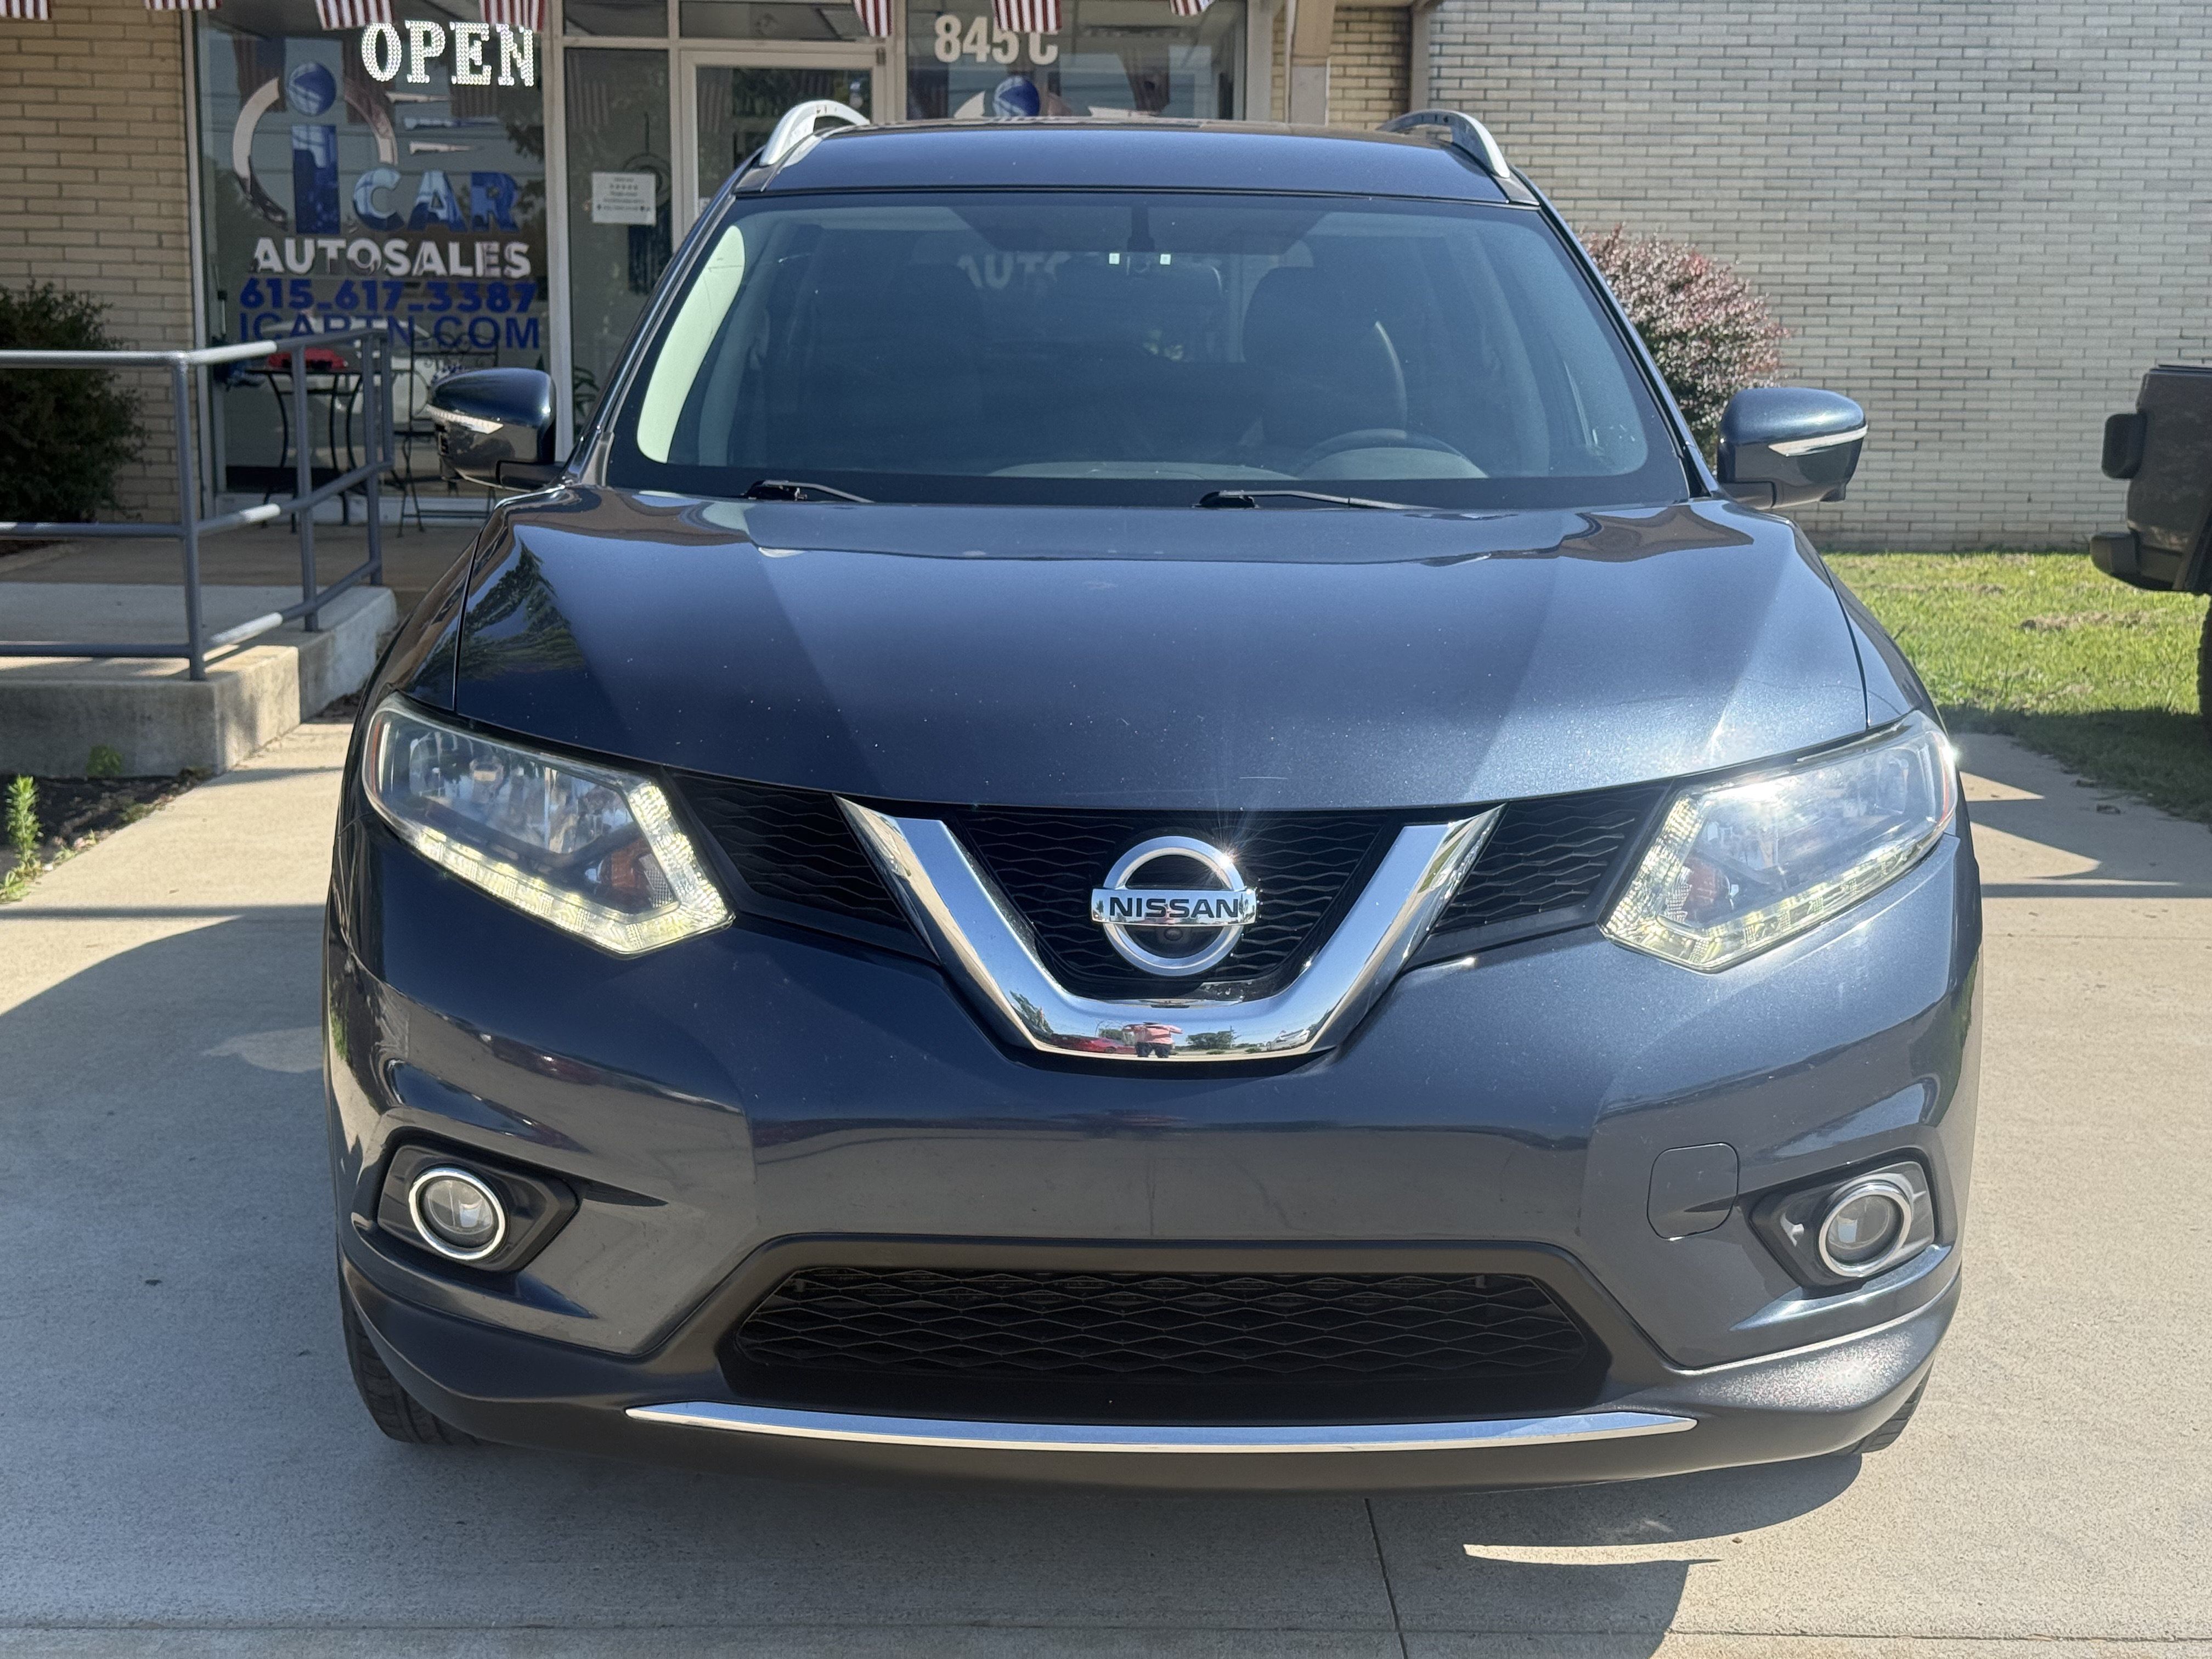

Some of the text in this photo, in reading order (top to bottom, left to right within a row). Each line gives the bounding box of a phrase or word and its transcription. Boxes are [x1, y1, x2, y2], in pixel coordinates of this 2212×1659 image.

[361, 20, 534, 87] OPEN
[934, 14, 1019, 64] 845
[251, 237, 531, 279] AUTOSALES
[1110, 897, 1238, 918] NISSAN
